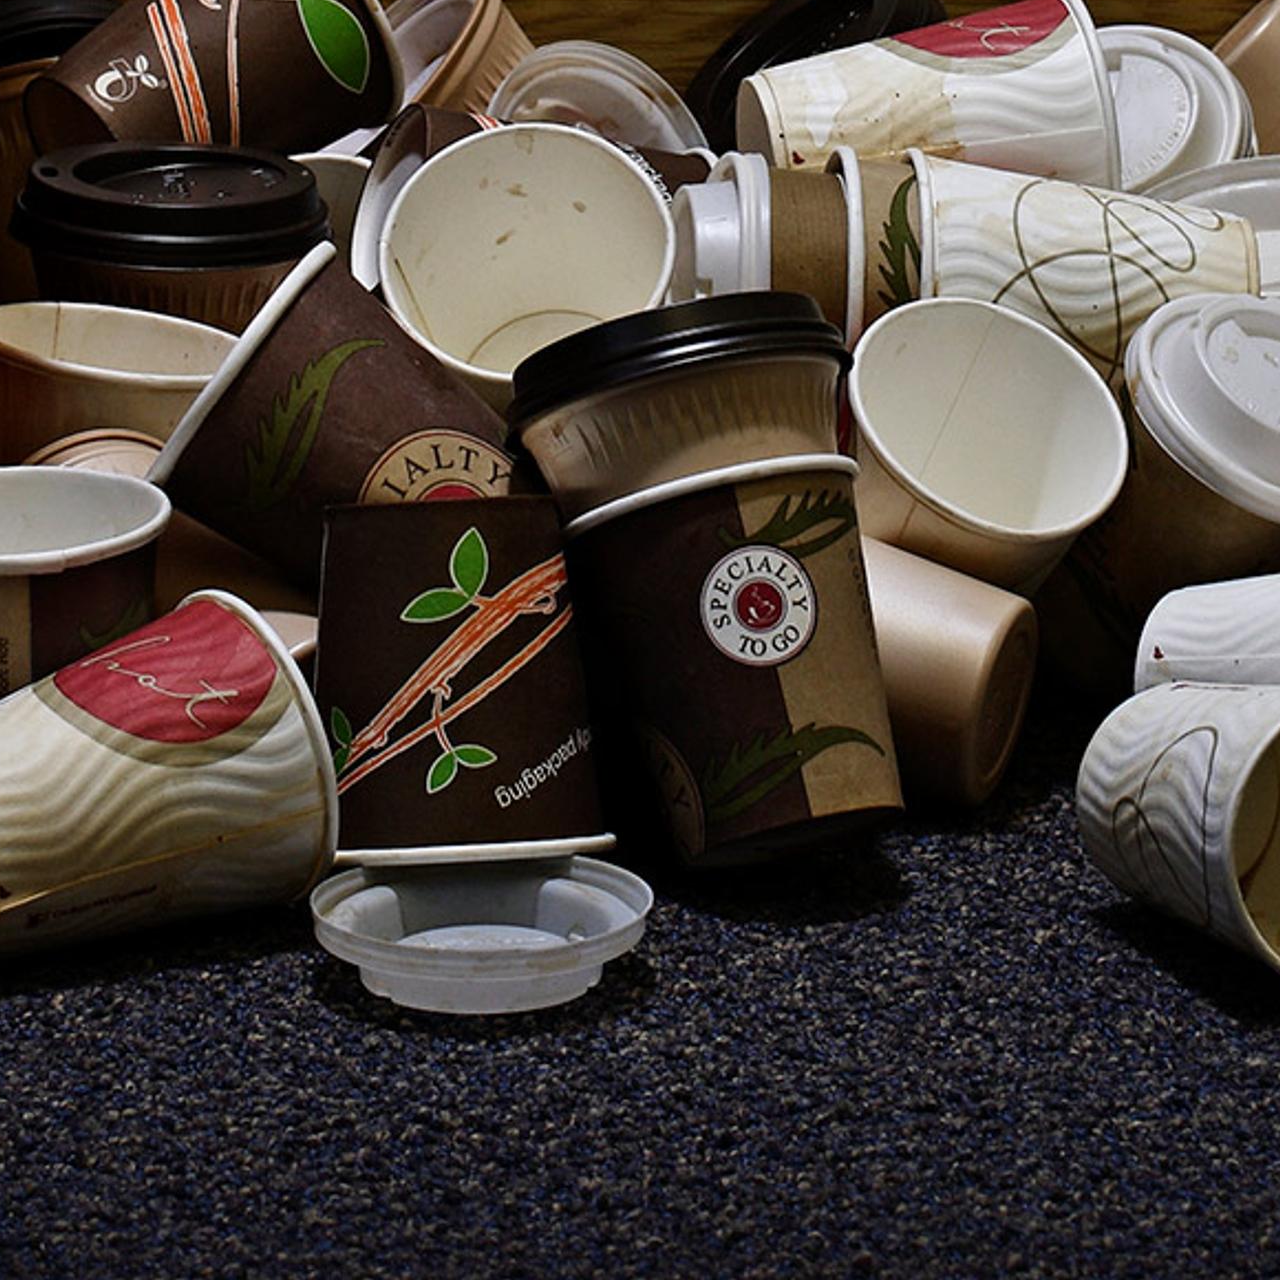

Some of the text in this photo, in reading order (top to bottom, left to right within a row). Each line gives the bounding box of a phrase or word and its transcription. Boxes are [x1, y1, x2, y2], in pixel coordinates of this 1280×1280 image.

[381, 444, 512, 499] IALTY
[710, 556, 809, 629] SPECIALTY
[739, 625, 800, 656] TO GO
[80, 636, 239, 729] hot
[494, 734, 578, 808] packaging
